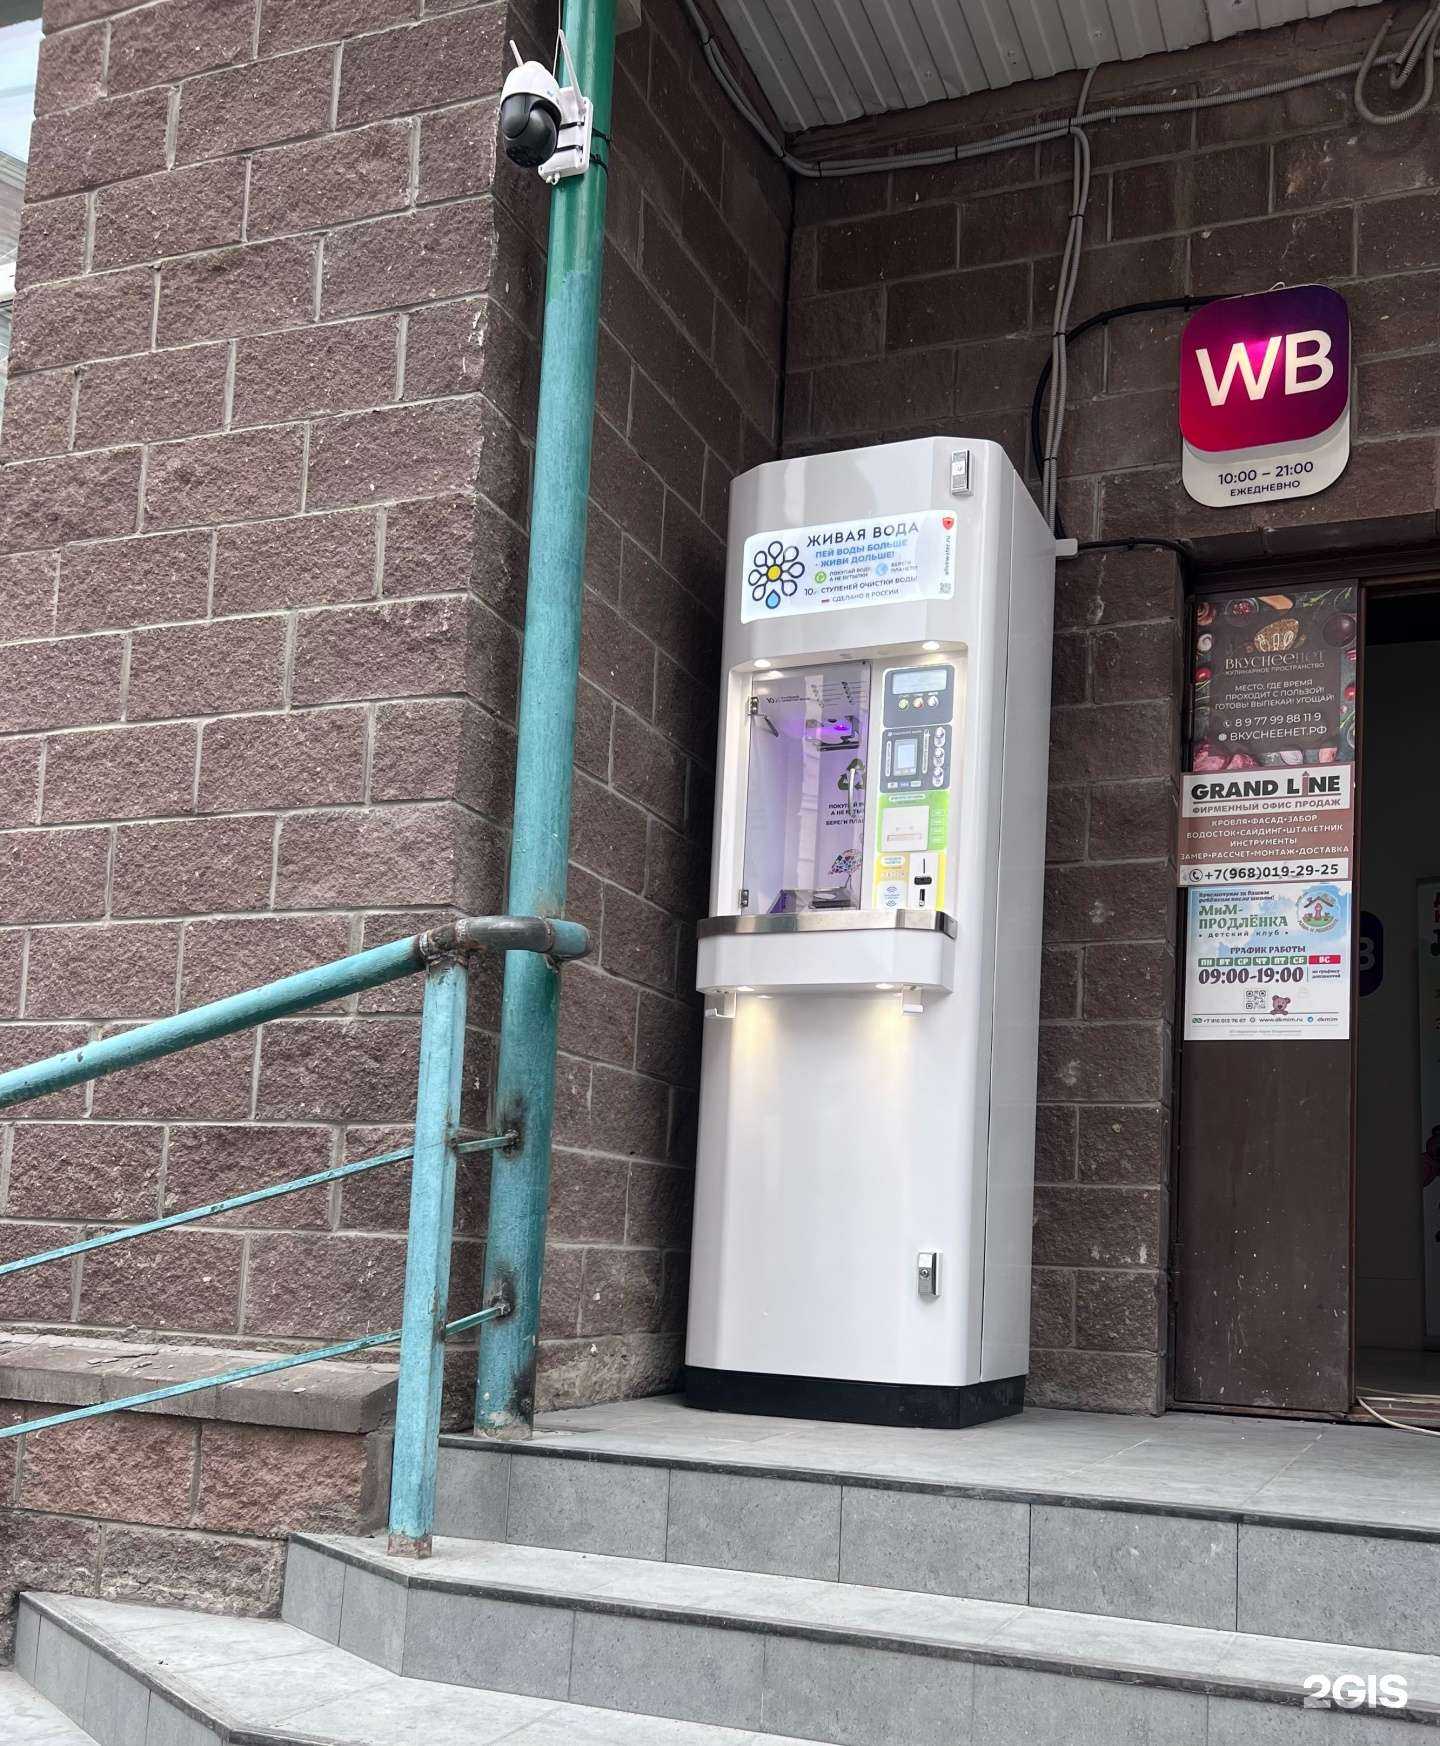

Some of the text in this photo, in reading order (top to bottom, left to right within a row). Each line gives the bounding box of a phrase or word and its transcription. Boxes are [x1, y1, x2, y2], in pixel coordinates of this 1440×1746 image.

[1195, 329, 1334, 407] WB
[1218, 469, 1257, 485] 10:00
[1275, 461, 1314, 477] 21:00
[1230, 480, 1301, 497] ЕЖЕДНЕВНО
[806, 522, 919, 547] ЖИВАЯ ВОДА
[815, 539, 908, 558] ПЕЙ ВОДЫ БОЛЬШЕ
[820, 557, 849, 567] ЖИВИ
[850, 551, 895, 564] ДОЛЬШЕ!
[821, 583, 858, 594] СТУПЕНЕЙ
[859, 577, 893, 589] ОЧИСТКИ
[1271, 662, 1325, 673] ПРОСТРАНСТВО
[1266, 682, 1281, 690] ГДЕ
[1283, 679, 1313, 688] ВРЕМЯ
[1225, 690, 1271, 701] ПРОХОДИТ
[1235, 712, 1321, 727] 8 9 77 99 88 11 9
[1230, 725, 1327, 741] ВКУСНЕЕНЕТ.РФ
[1191, 780, 1278, 800] GRAND
[1192, 799, 1341, 814] ФИРМЕННЫЙ ОФИС ПРОДАЖ
[1211, 814, 1318, 827] КРОВЛЯ ФАСАД ЗАБОР
[1186, 824, 1344, 839] ВОДОСТОК САЙДИНГ ШТАКЕТНИК
[1230, 837, 1297, 848] ИНСТРУМЕНТЫ
[1180, 852, 1208, 861] ЗАМЕР
[1254, 848, 1295, 857] МОНТАЖ
[1299, 846, 1349, 856] ДОСТАВКА
[1204, 864, 1339, 882] +7(968)019-29-25
[1199, 904, 1243, 916] МиМ-
[1199, 914, 1288, 931] ПРОДЛЁНКА
[1208, 929, 1280, 938] детский клуб
[1230, 945, 1306, 954] ГРАФИК РАБОТЫ
[1198, 967, 1304, 984] 09:00-19:00
